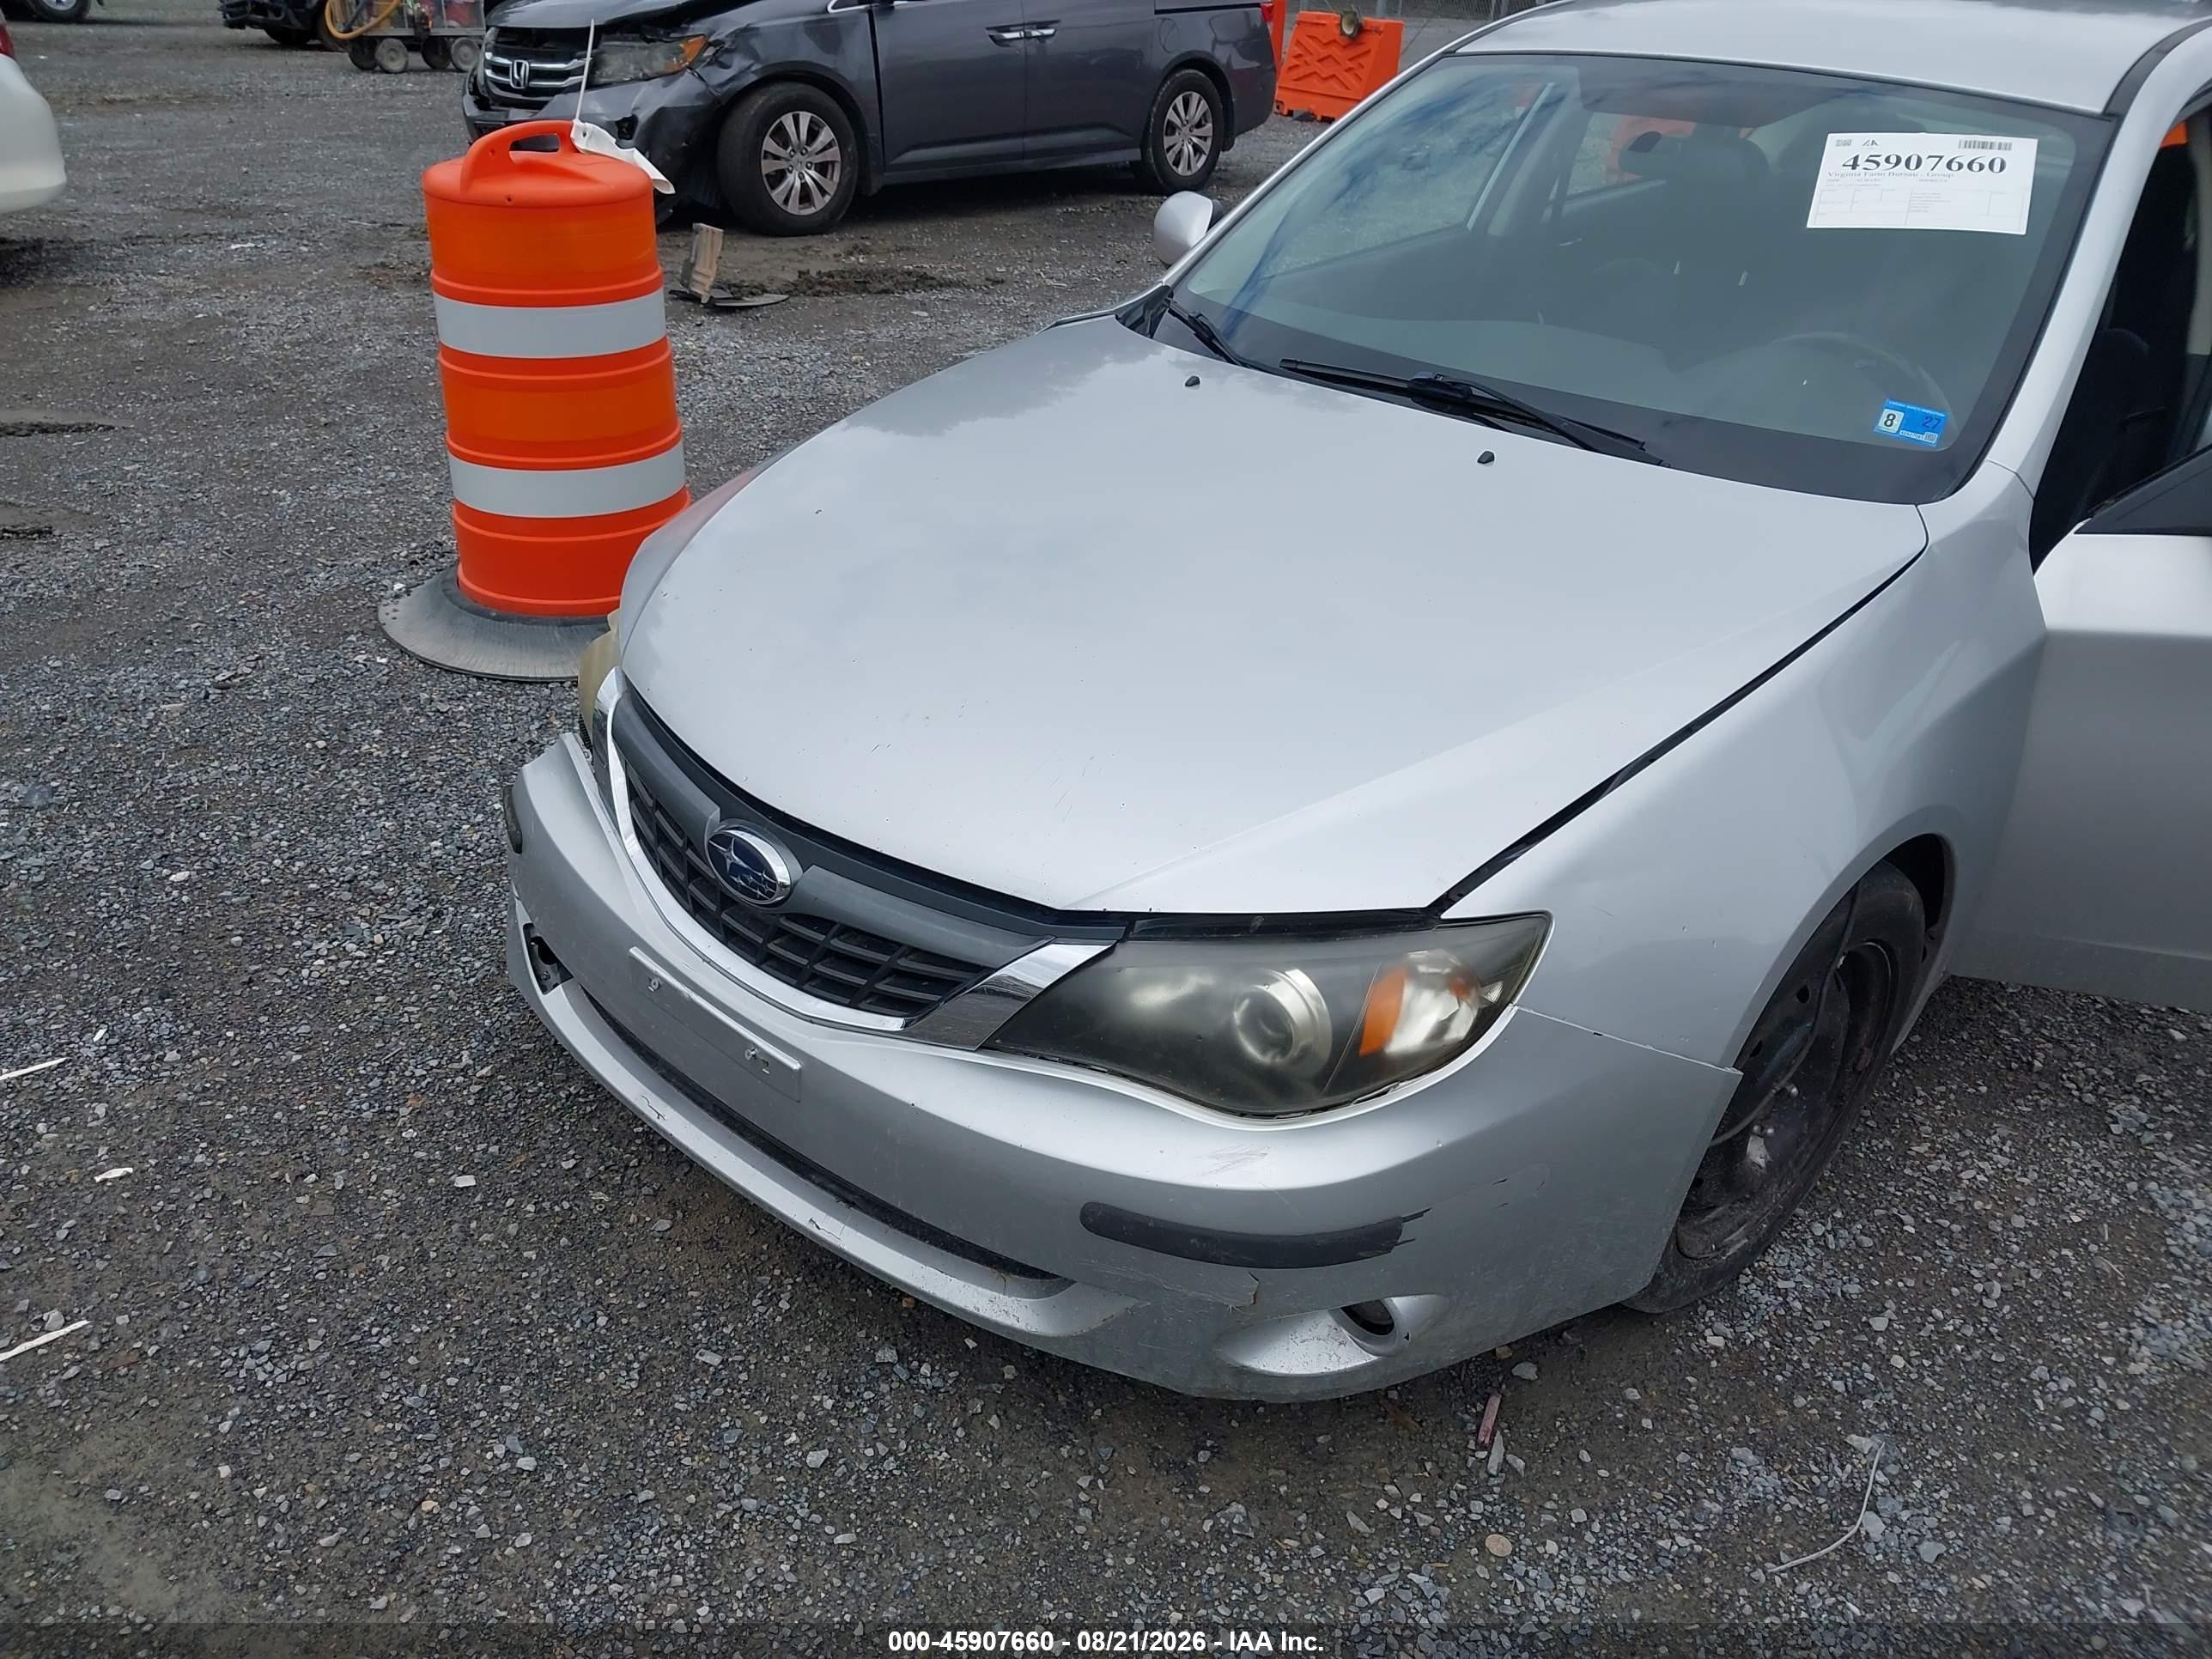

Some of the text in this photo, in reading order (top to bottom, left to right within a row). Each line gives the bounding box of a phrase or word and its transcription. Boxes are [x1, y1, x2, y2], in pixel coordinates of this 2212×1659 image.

[1841, 154, 2007, 173] 45907660
[1883, 413, 1942, 430] 8 27
